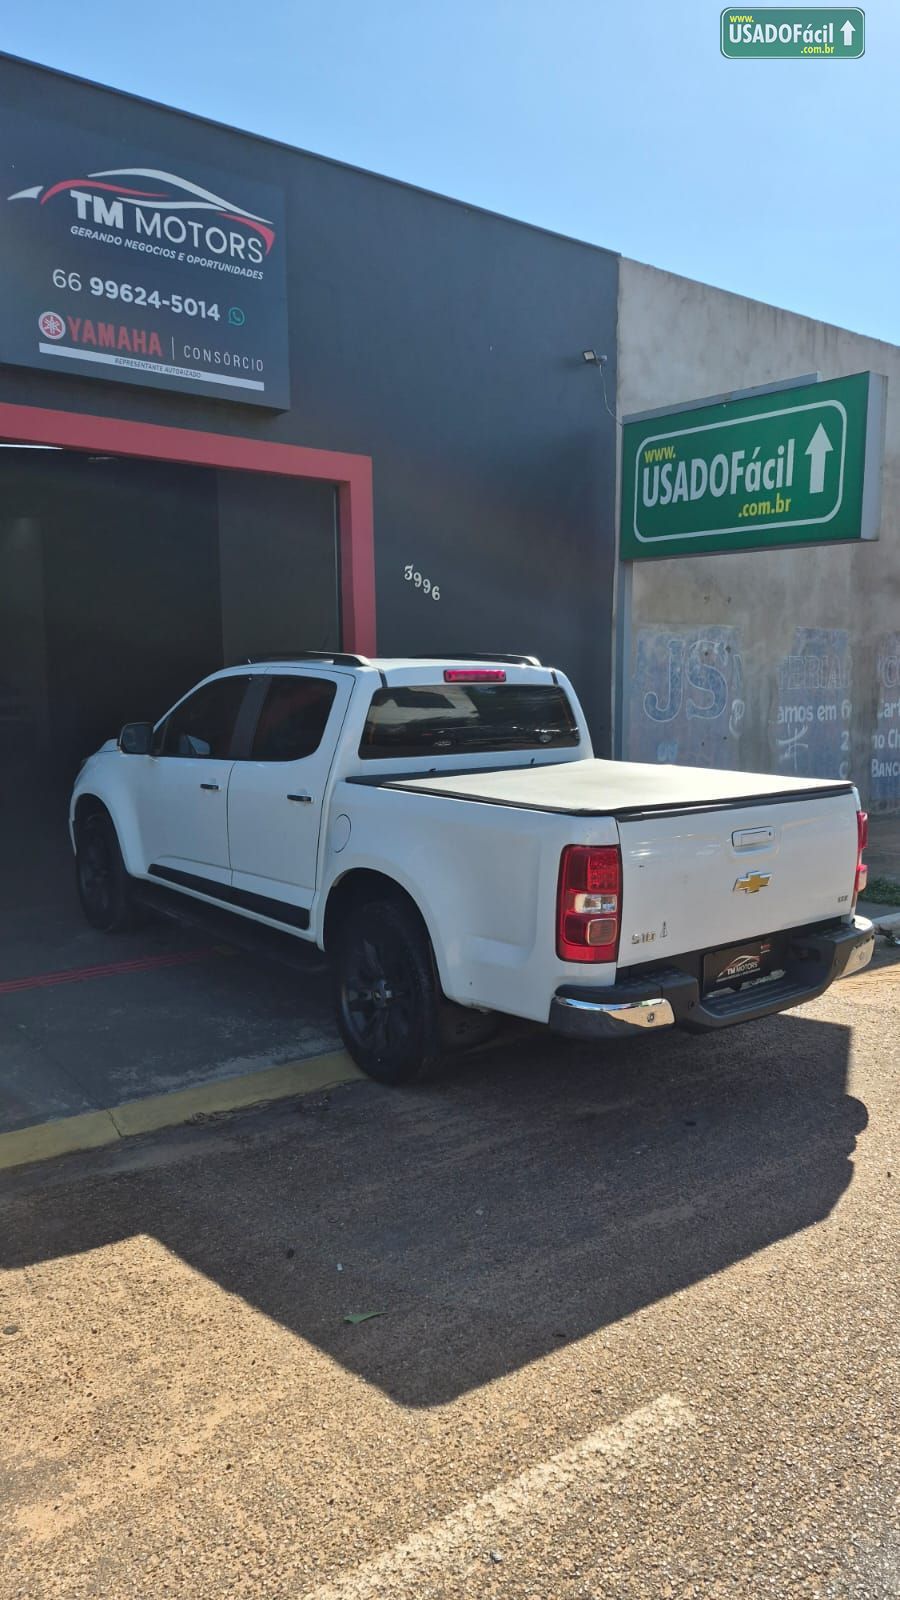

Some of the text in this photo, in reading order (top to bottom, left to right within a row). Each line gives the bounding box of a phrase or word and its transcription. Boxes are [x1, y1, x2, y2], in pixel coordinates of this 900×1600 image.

[70, 189, 263, 264] TM MOTORS
[70, 225, 264, 280] GERANDO NEGOCIOS E OPORTUNIDADES
[52, 268, 221, 321] 66 99624-5014
[67, 315, 164, 357] YAMAHA
[114, 357, 202, 379] REPRESENTANTE AUTORIZADO
[642, 438, 796, 508] USADOFácil
[643, 445, 676, 464] www.
[738, 493, 792, 518] .com.br
[404, 563, 441, 601] 3996
[643, 639, 729, 723] JS
[816, 704, 837, 721] em
